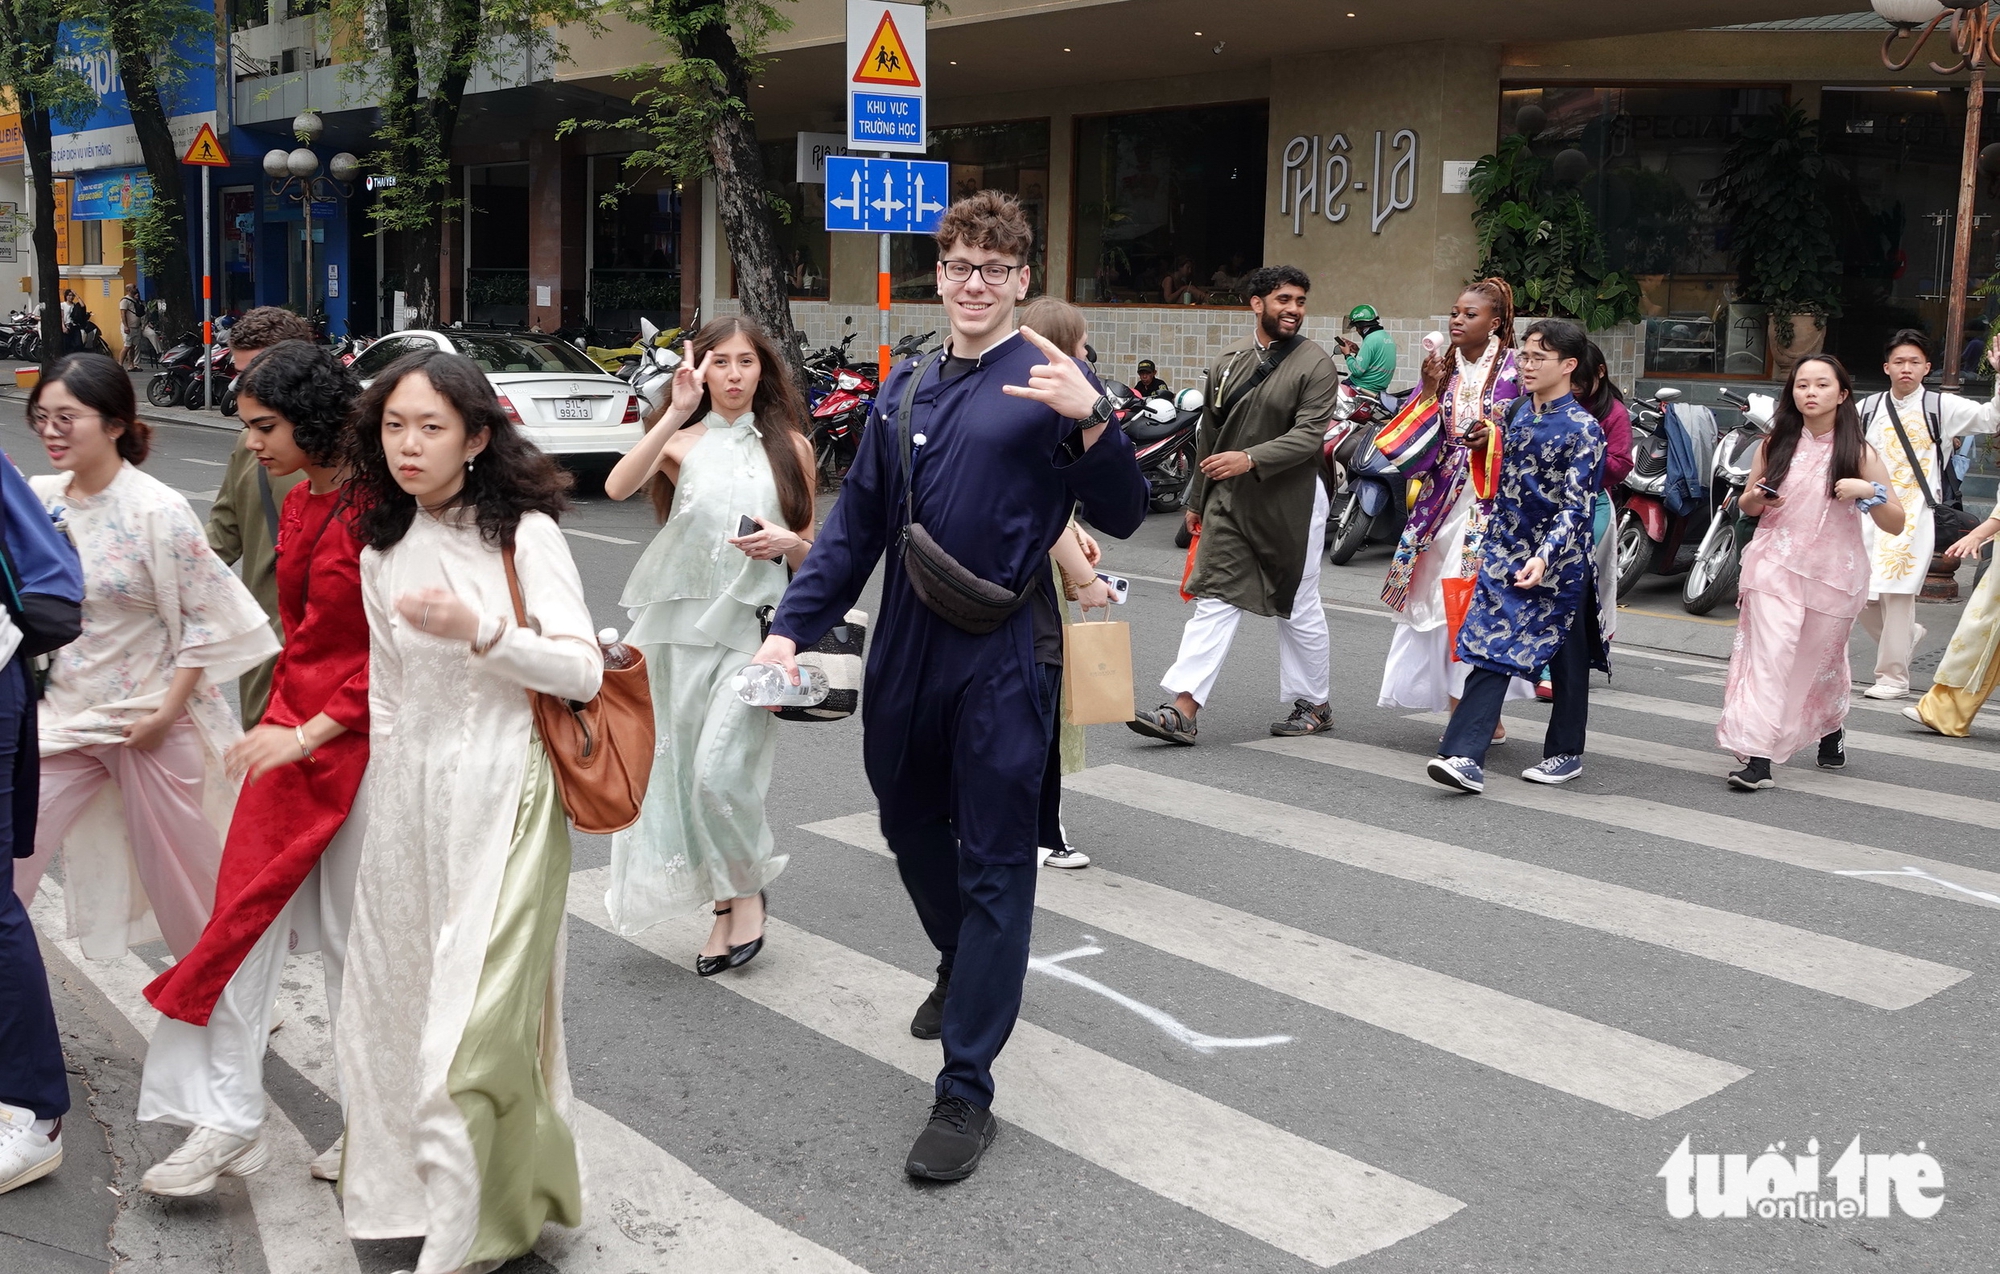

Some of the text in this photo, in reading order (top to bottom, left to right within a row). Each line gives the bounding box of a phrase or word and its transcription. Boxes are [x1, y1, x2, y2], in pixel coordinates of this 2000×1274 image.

[867, 100, 909, 118] KHU VỰC
[859, 117, 917, 139] TRƯỜNG HỌC
[66, 148, 77, 162] DỊCH
[95, 142, 112, 157] THÔNG
[565, 399, 581, 409] 51L
[560, 409, 589, 418] 992.13
